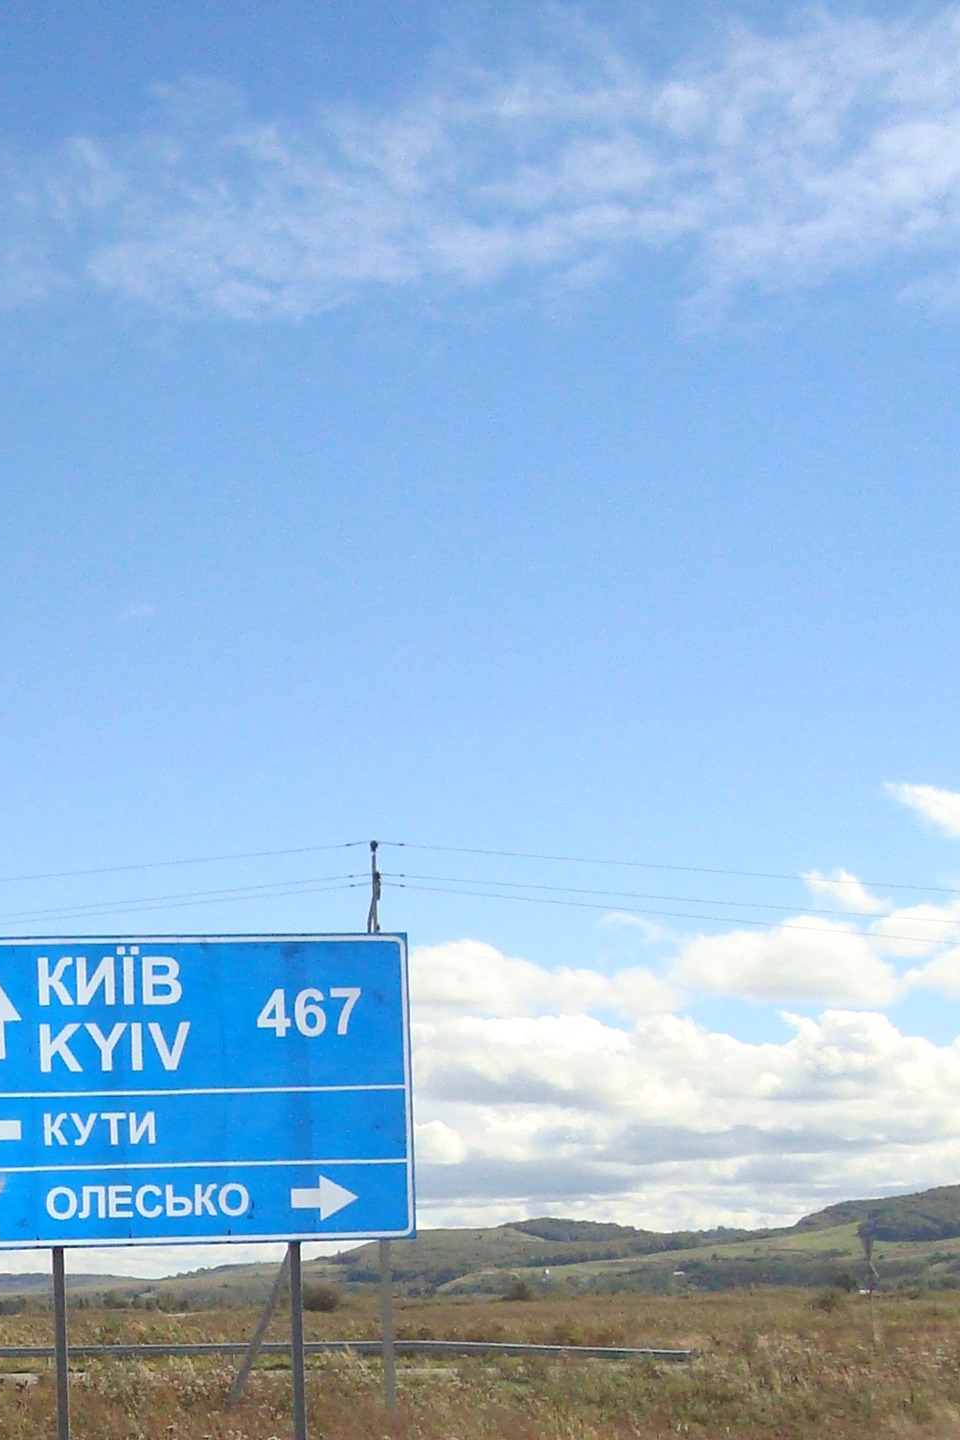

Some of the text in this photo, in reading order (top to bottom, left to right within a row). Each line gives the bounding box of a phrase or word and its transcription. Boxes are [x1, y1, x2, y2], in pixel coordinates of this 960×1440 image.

[37, 946, 182, 1006] КИЇВ
[257, 988, 361, 1037] 467
[40, 1022, 190, 1072] KYIV
[44, 1112, 156, 1146] КУТИ
[46, 1184, 250, 1220] ОЛЕСЬКО
